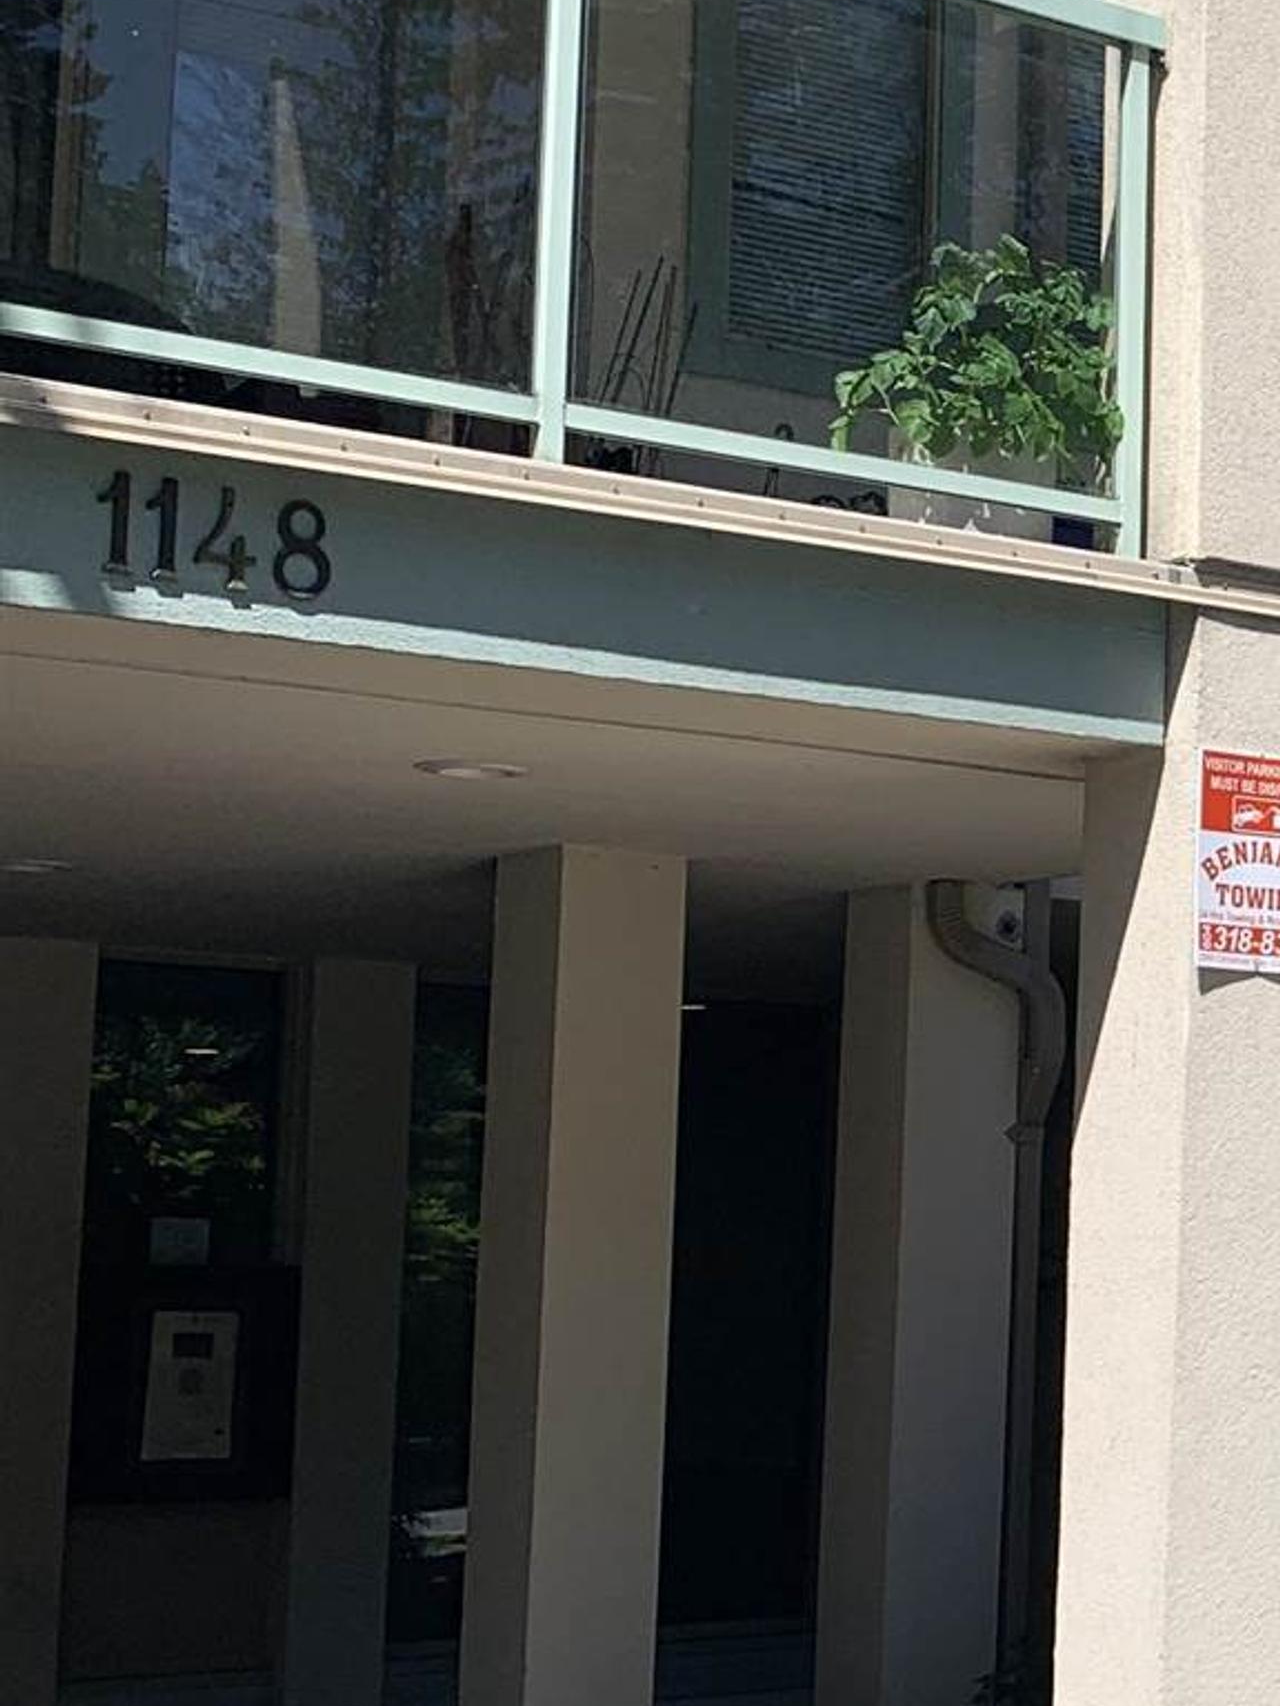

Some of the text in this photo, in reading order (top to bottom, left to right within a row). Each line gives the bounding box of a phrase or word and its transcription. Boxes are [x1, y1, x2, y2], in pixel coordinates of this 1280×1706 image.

[97, 470, 331, 600] 1148
[1205, 757, 1246, 774] VISITOR
[1210, 775, 1239, 791] MUST
[1241, 779, 1257, 794] BE
